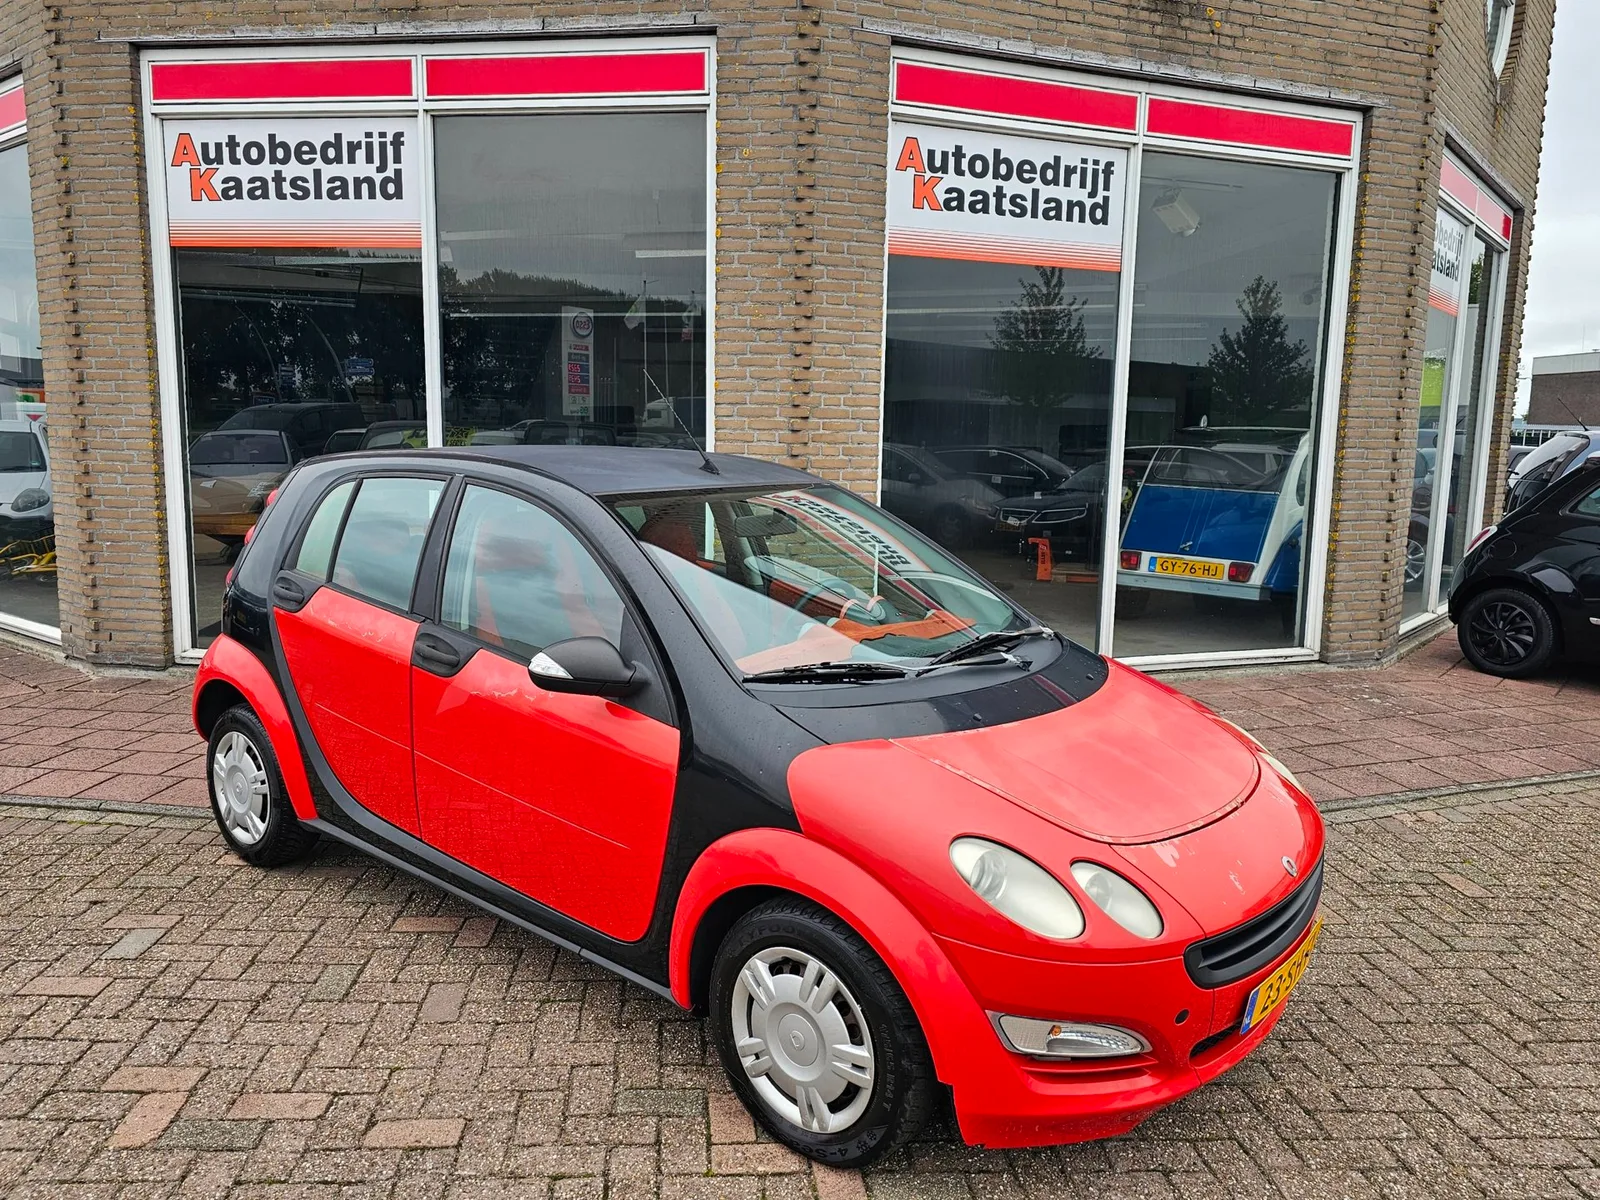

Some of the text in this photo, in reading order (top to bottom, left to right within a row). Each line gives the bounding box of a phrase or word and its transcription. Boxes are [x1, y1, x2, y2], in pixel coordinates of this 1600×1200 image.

[171, 131, 405, 174] Autobedrijf
[895, 136, 1115, 199] Autobedrijf
[189, 167, 404, 201] Kaatsland
[912, 174, 1110, 226] Kaatsland
[1160, 560, 1218, 577] GY-76-HJ
